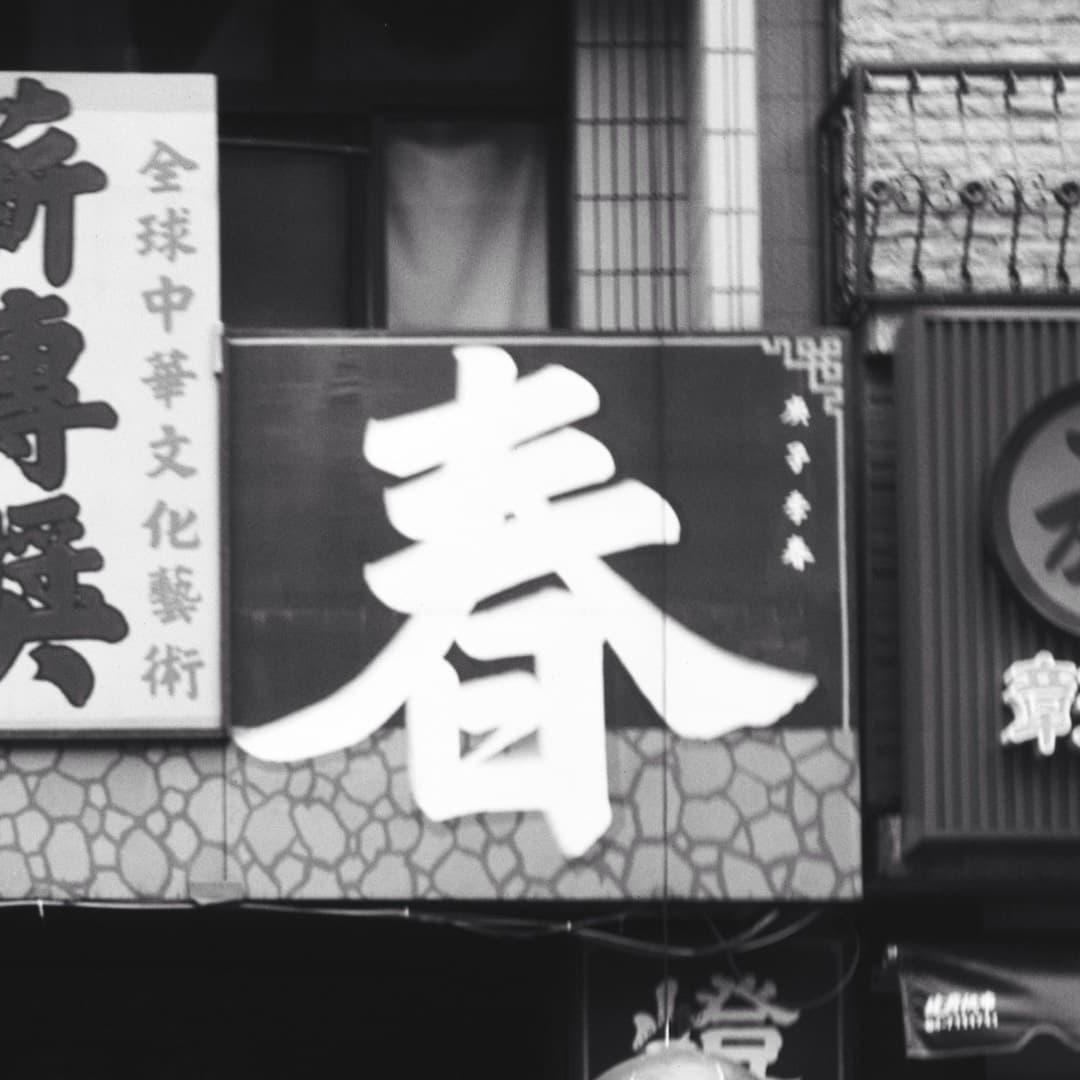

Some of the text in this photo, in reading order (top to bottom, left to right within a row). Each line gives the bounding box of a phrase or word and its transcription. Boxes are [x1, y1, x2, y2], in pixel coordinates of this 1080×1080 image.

[136, 140, 205, 701] 全球中華文化藝術
[232, 345, 818, 858] 春
